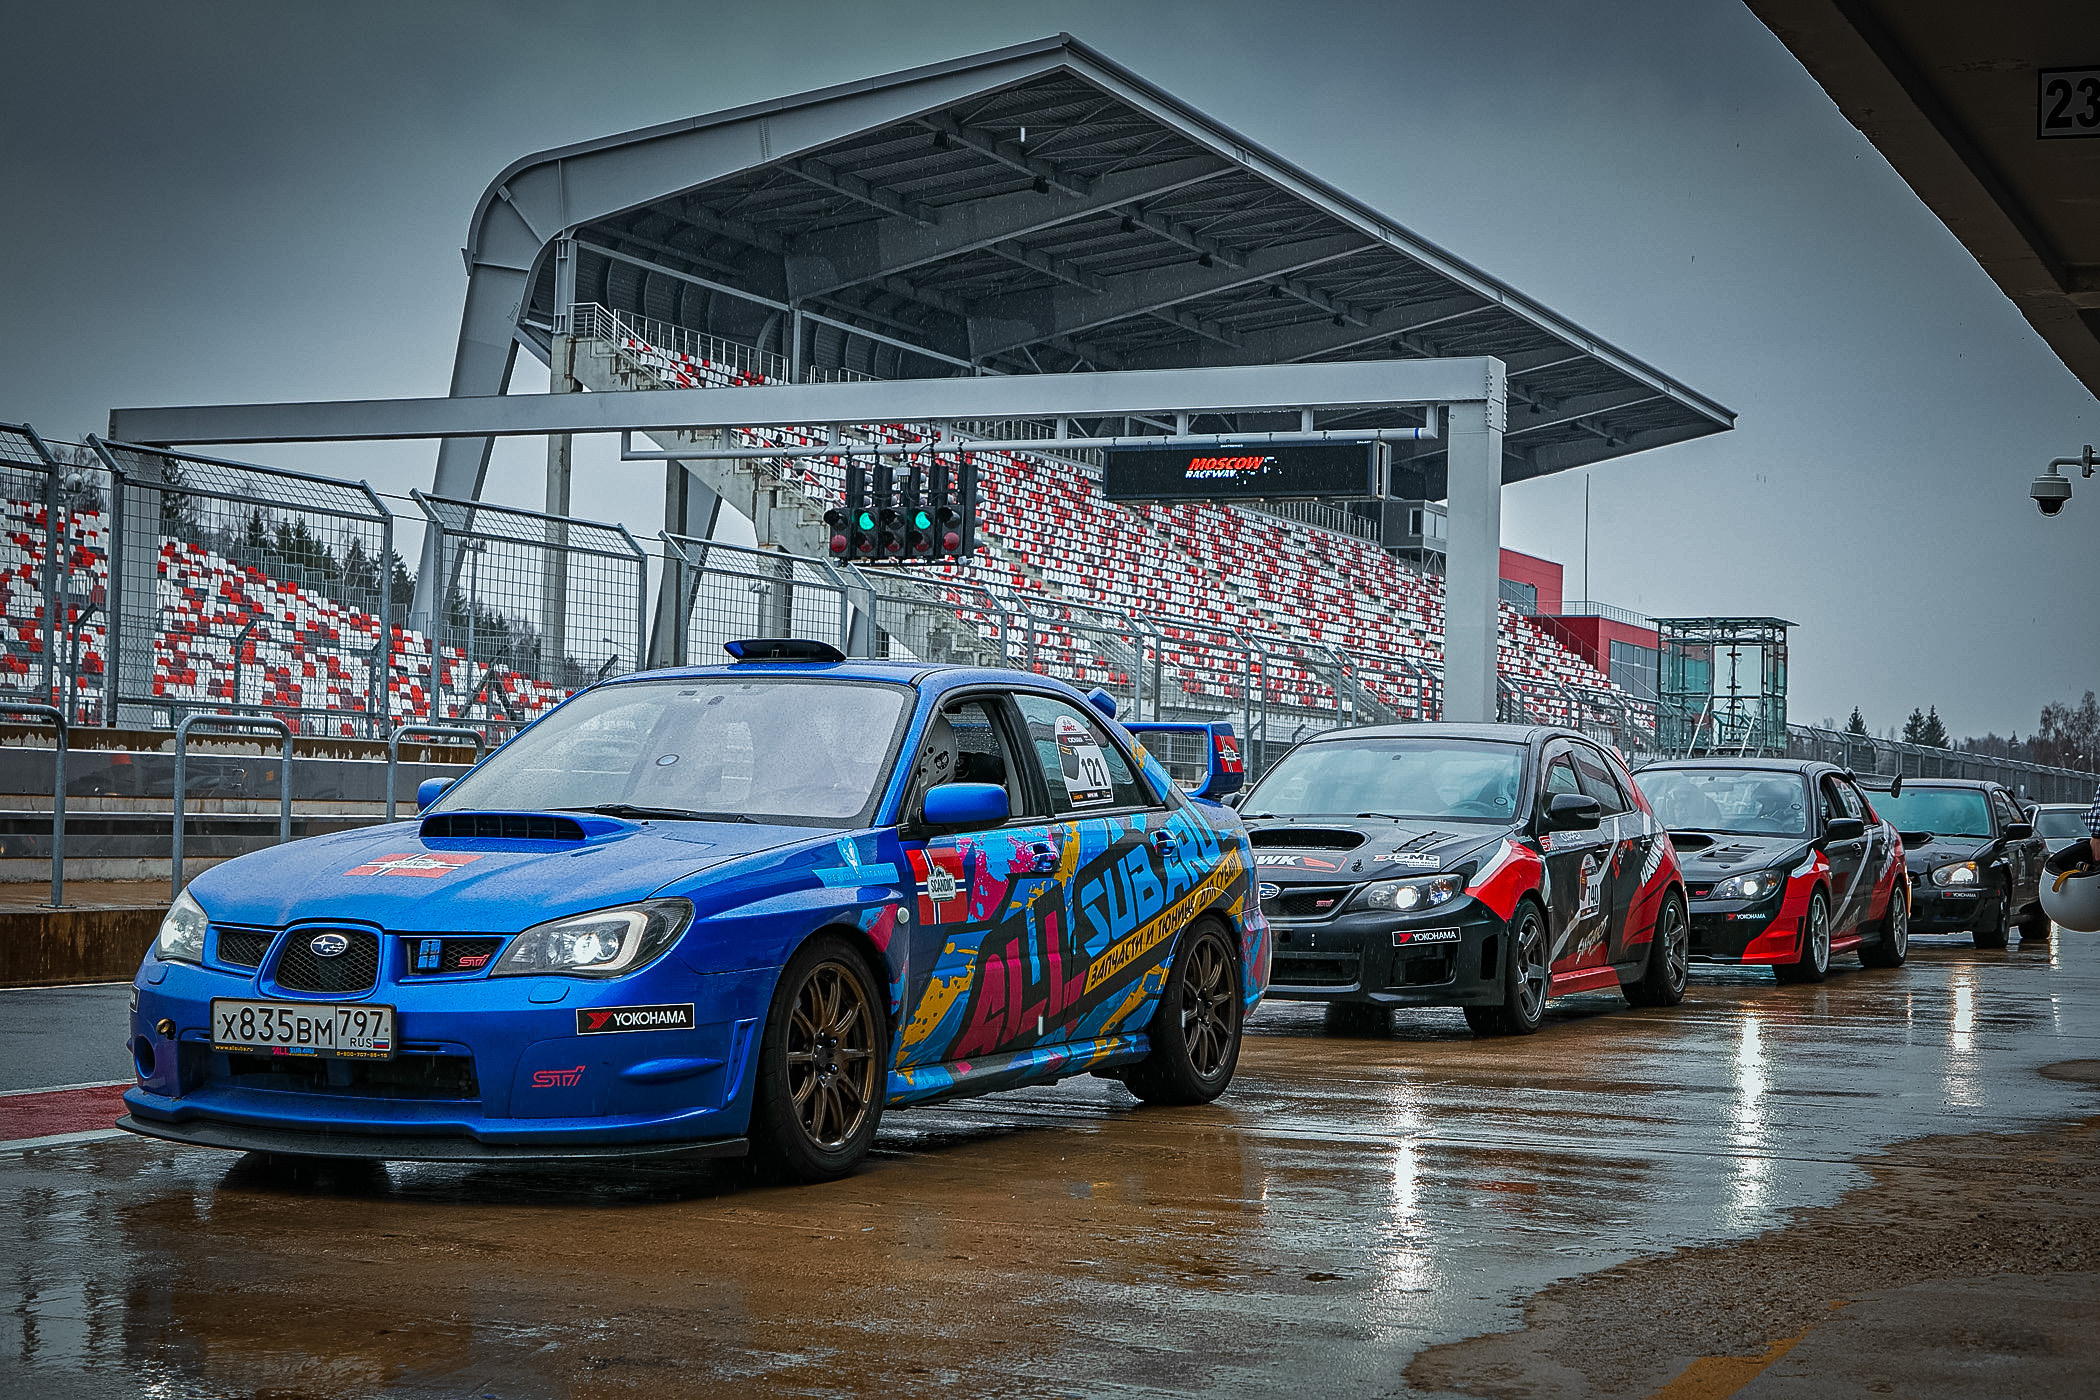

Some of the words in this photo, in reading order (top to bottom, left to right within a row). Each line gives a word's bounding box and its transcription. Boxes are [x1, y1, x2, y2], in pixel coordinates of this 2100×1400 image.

[2045, 77, 2100, 129] 23
[1188, 456, 1265, 470] MOSCOW
[1081, 757, 1108, 786] 121
[1255, 855, 1301, 866] WK
[930, 877, 953, 893] SCANDIC
[1081, 800, 1222, 958] SUBARU
[1413, 930, 1457, 941] YOKOHAMA
[1089, 934, 1145, 988] ЗАПЧАСТИ
[1145, 928, 1155, 945] И
[952, 911, 1086, 1059] ALL
[338, 1009, 383, 1037] 797
[613, 1010, 687, 1027] YOKOHAMA
[350, 1038, 372, 1048] RUS
